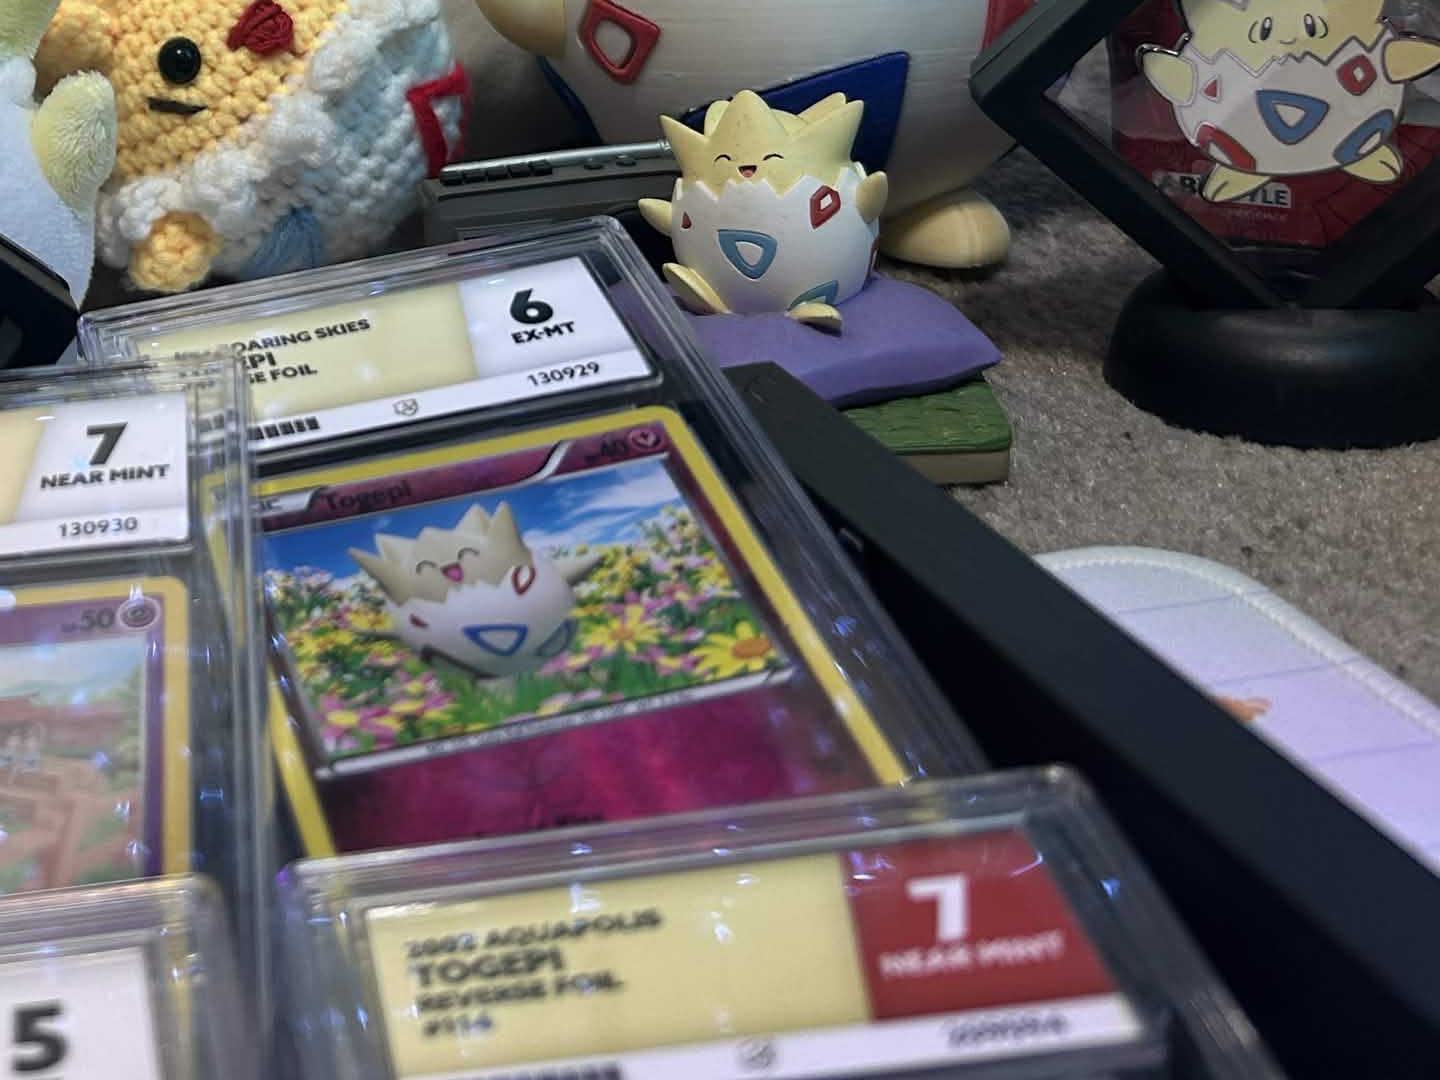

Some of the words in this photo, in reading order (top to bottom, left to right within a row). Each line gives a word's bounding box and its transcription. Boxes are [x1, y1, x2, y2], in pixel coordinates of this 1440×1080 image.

[510, 288, 553, 324] 6
[226, 329, 312, 358] OARING
[314, 318, 371, 341] SKIES
[511, 320, 575, 344] EX-MT
[271, 363, 317, 383] FOIL
[527, 361, 600, 386] 130929
[86, 421, 129, 466] 7
[39, 470, 103, 489] NEAR
[109, 463, 171, 482] MINT
[58, 516, 139, 537] 130930
[79, 608, 116, 633] 50
[9, 999, 70, 1073] 5
